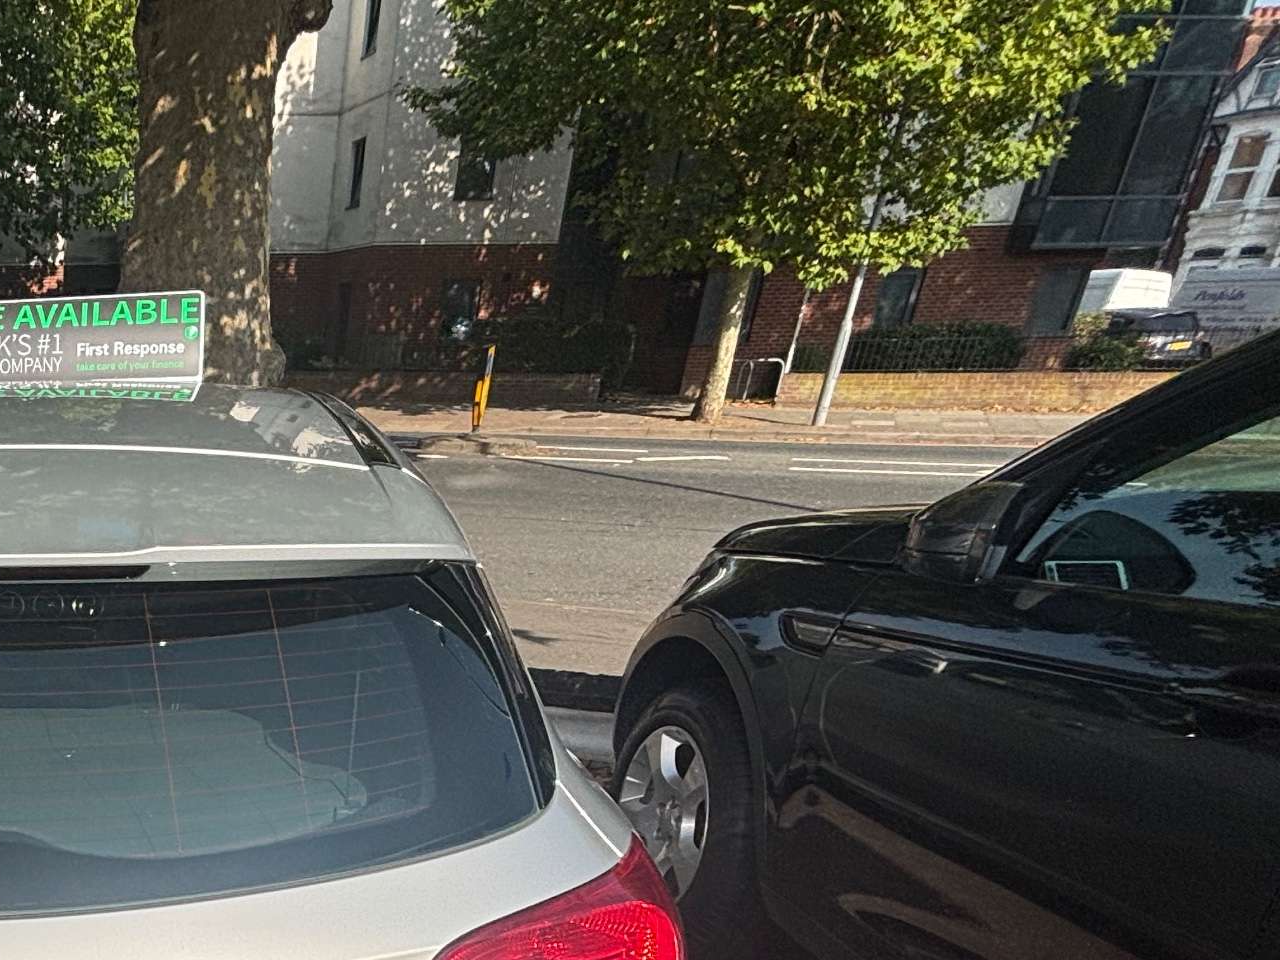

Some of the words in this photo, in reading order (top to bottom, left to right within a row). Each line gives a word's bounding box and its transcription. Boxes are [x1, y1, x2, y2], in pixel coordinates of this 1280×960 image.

[13, 297, 200, 330] AVAILABLE
[38, 333, 63, 355] #1
[76, 342, 110, 357] First
[113, 341, 185, 358] Response
[76, 361, 96, 371] take
[97, 361, 115, 370] care
[117, 360, 127, 370] of
[127, 360, 150, 373] your
[151, 358, 185, 369] finance
